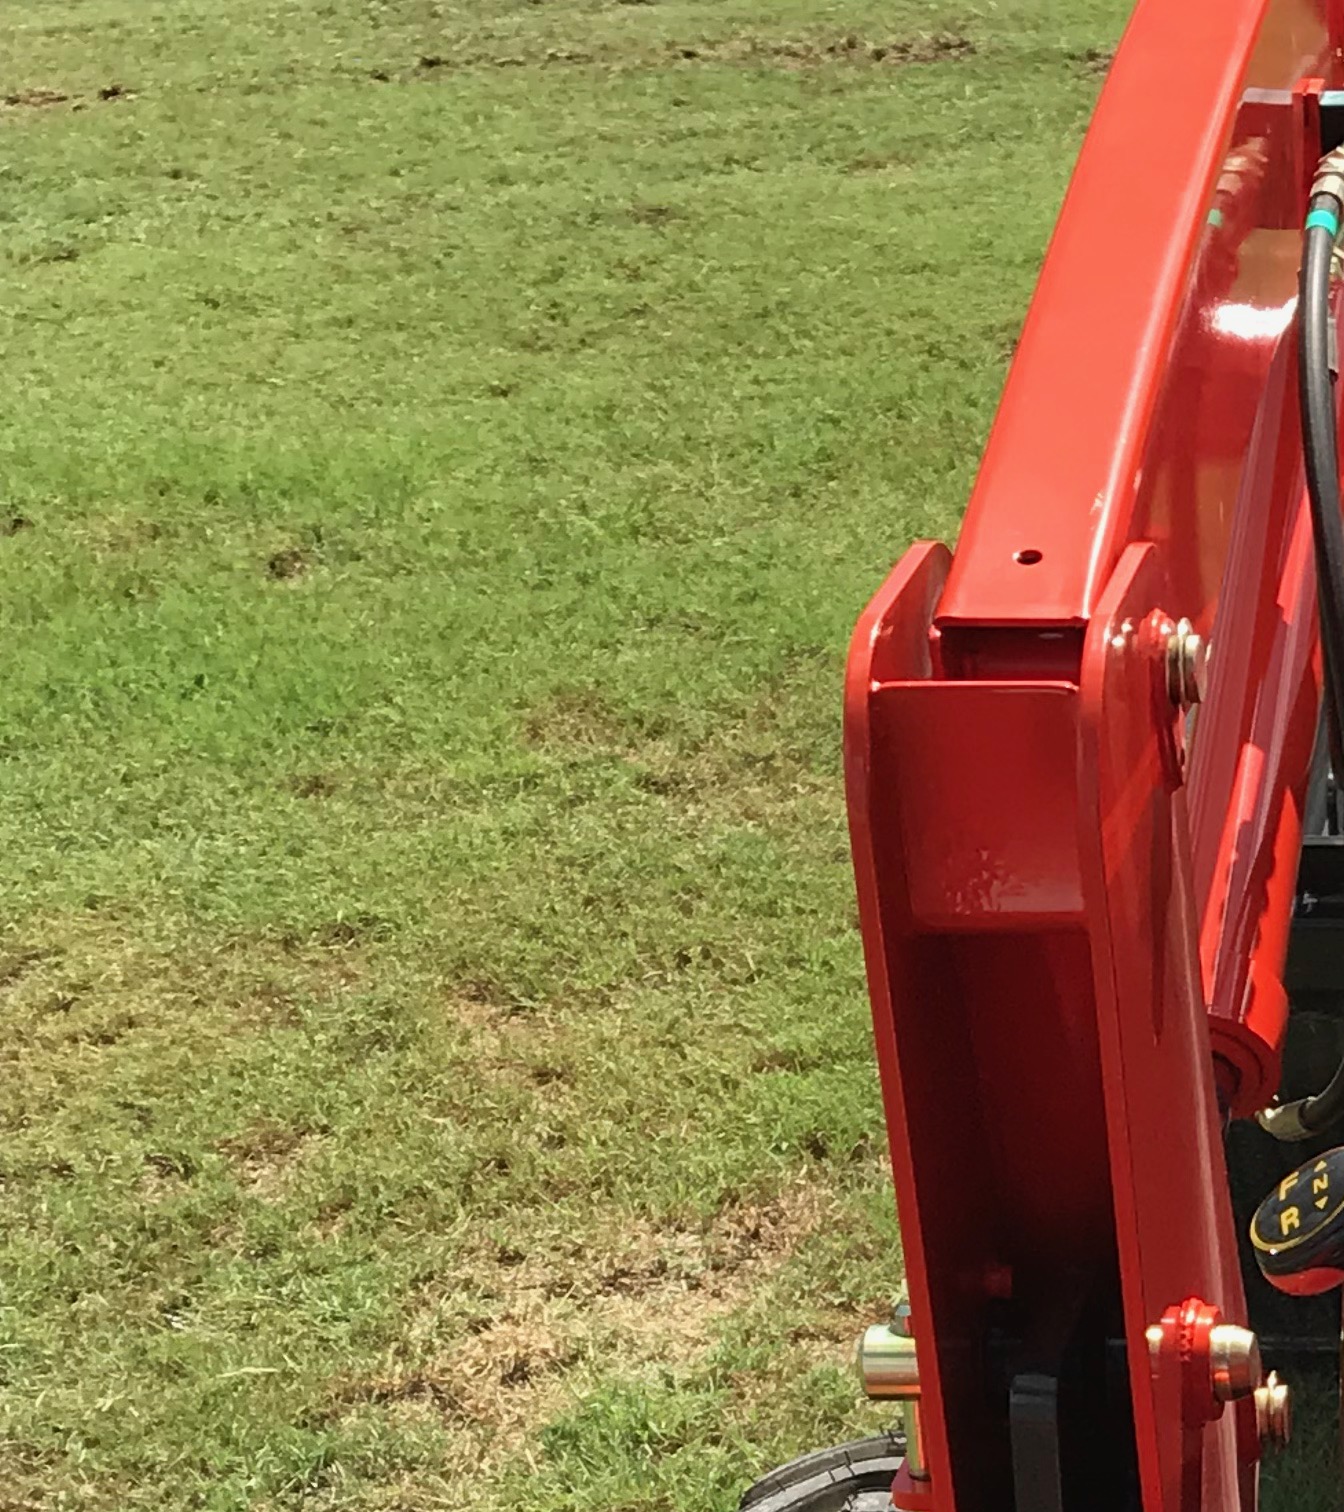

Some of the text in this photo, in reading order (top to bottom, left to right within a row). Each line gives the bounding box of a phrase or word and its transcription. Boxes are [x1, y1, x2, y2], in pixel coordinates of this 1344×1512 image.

[1278, 1171, 1299, 1201] F
[1313, 1173, 1329, 1195] N
[1279, 1205, 1300, 1236] R
